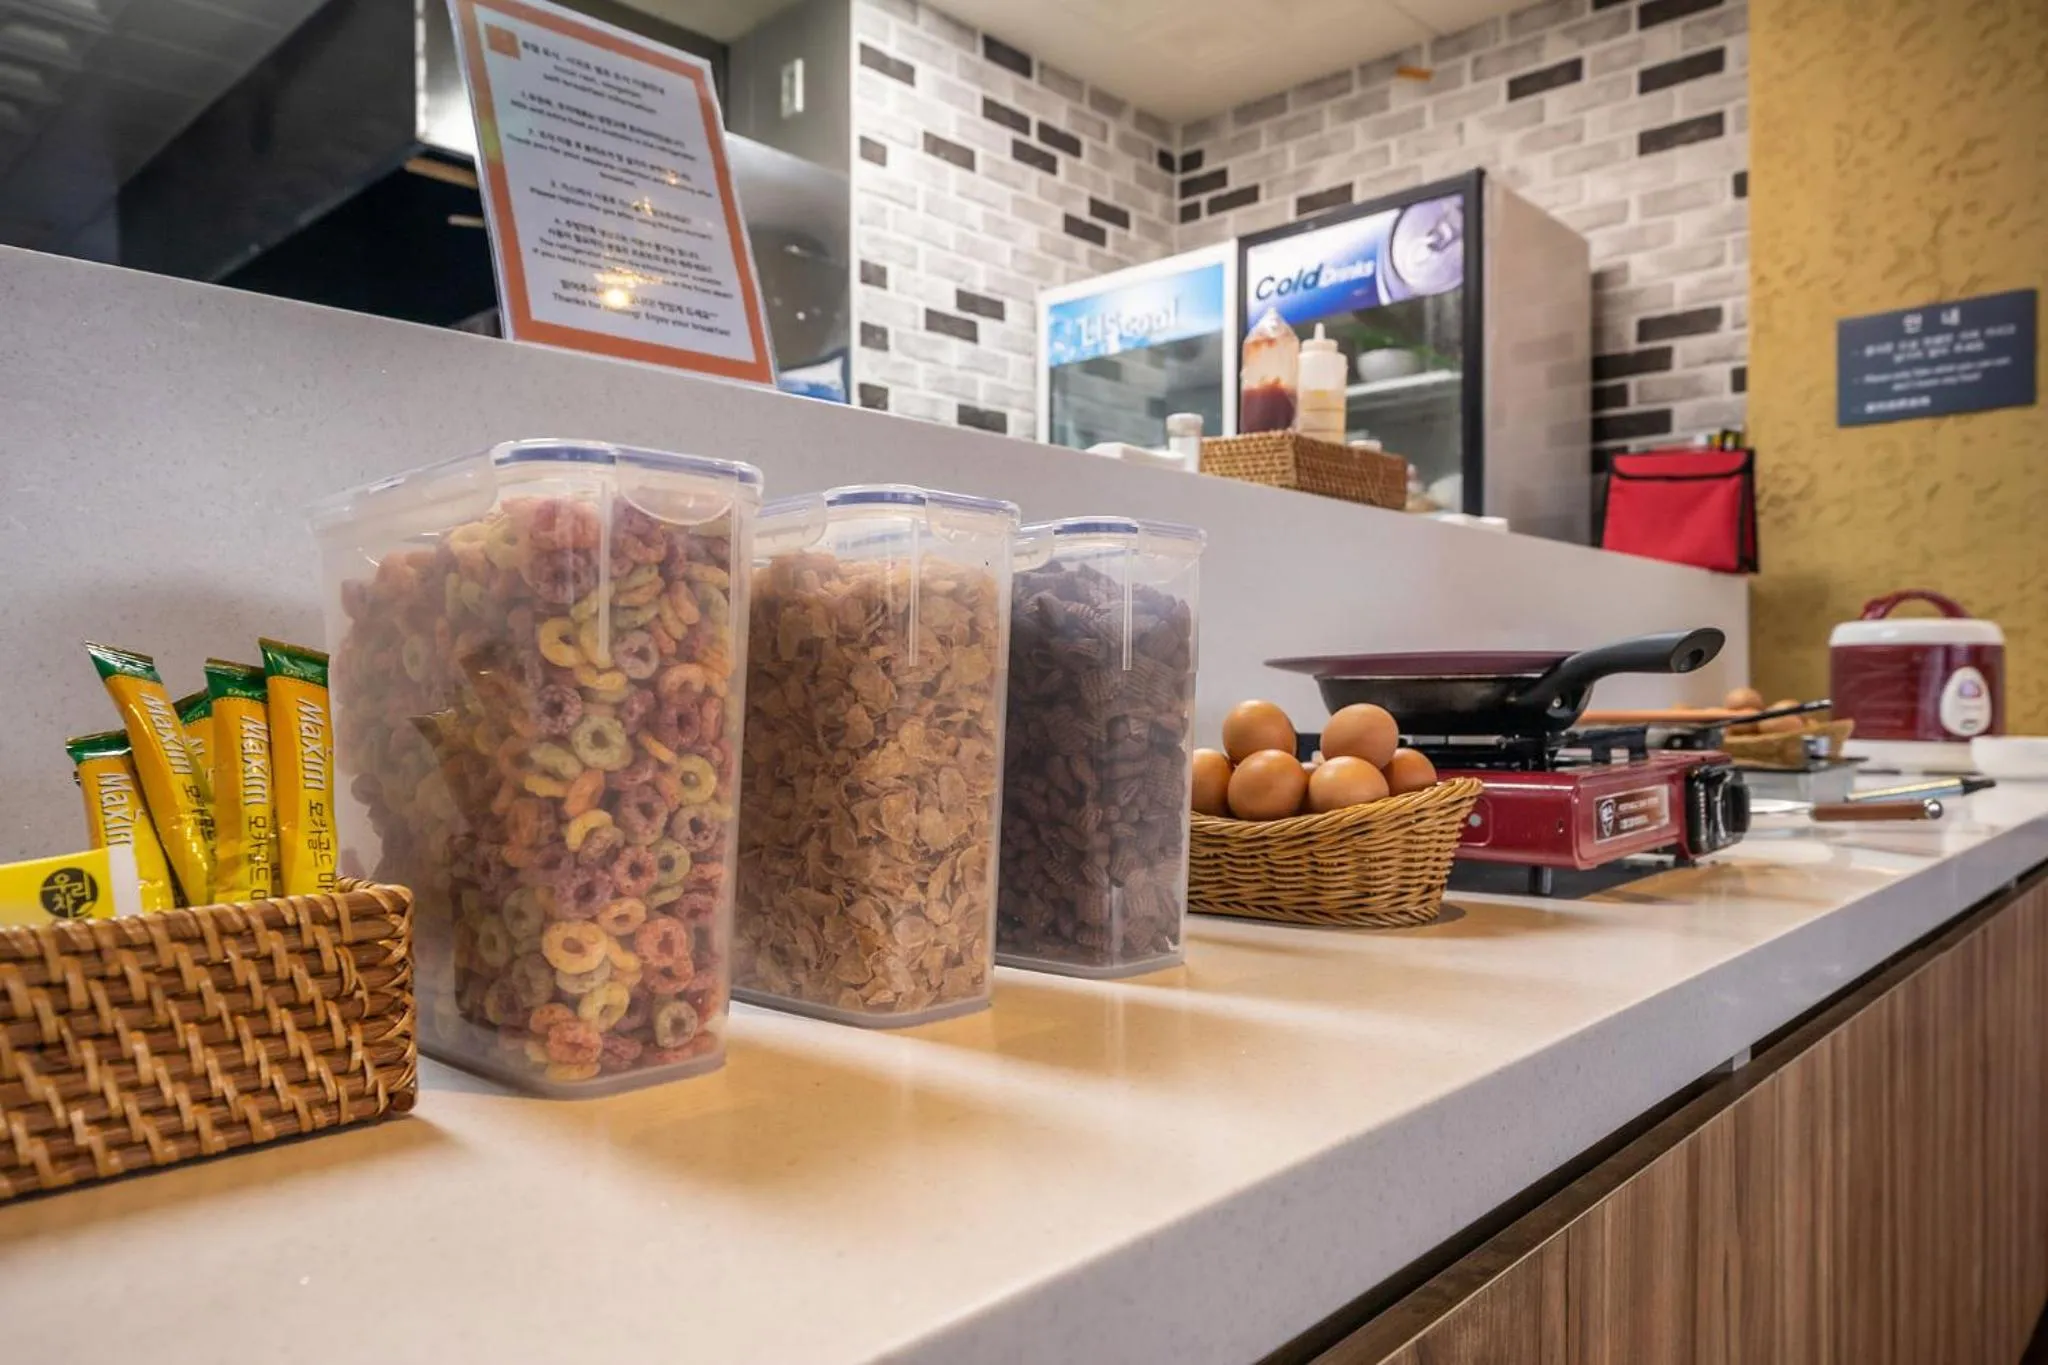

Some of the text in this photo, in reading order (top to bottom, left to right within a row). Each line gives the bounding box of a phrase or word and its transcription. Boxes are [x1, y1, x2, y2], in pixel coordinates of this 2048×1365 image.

[1256, 263, 1324, 301] Cold
[139, 692, 193, 775] Maxim
[240, 714, 270, 806] Maxim
[296, 697, 330, 791] Maxim
[97, 771, 137, 847] Maxim
[308, 799, 333, 868] 모카골드
